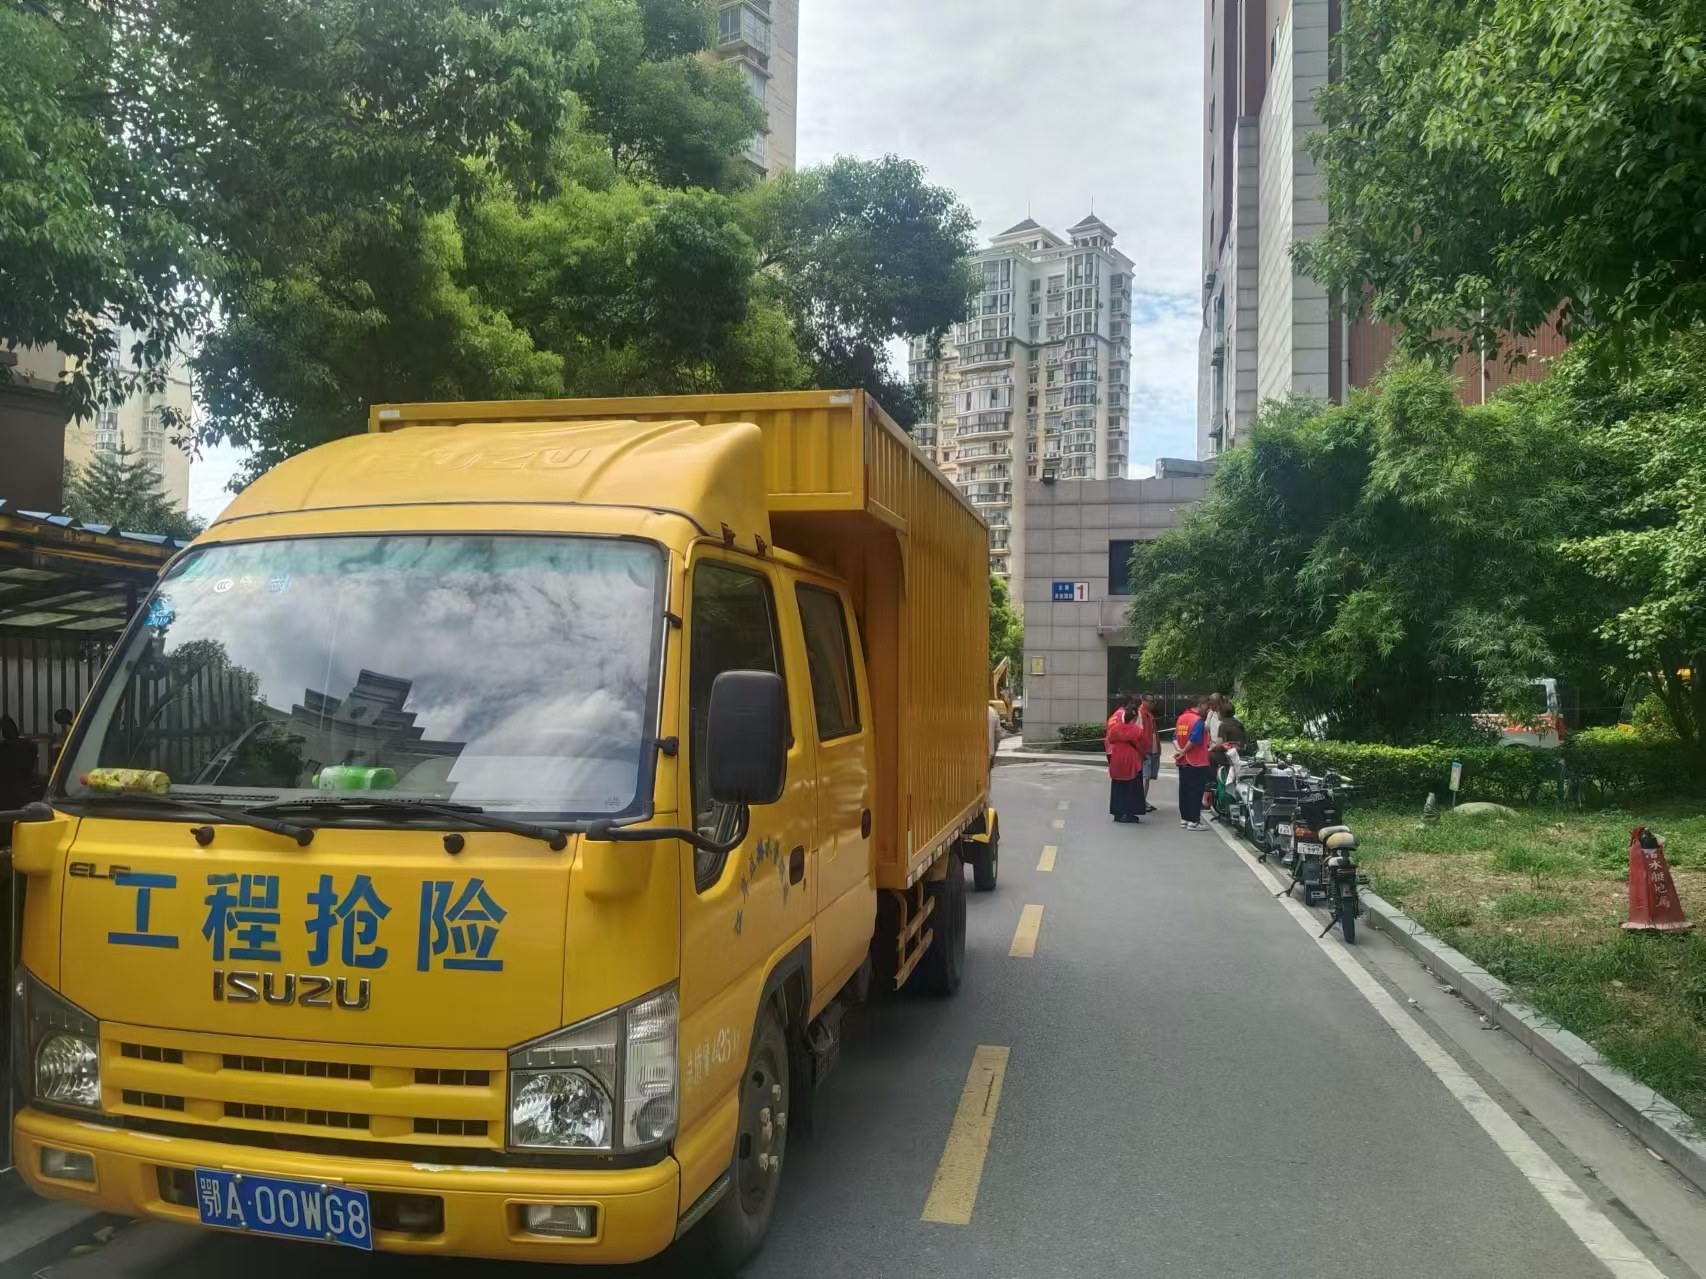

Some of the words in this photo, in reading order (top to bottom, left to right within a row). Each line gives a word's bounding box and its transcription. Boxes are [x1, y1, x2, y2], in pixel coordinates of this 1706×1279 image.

[1076, 584, 1084, 600] 1
[107, 873, 508, 972] 工程抢险
[213, 969, 371, 1010] ISUZU
[200, 1178, 367, 1239] 鄂A·00WG8
